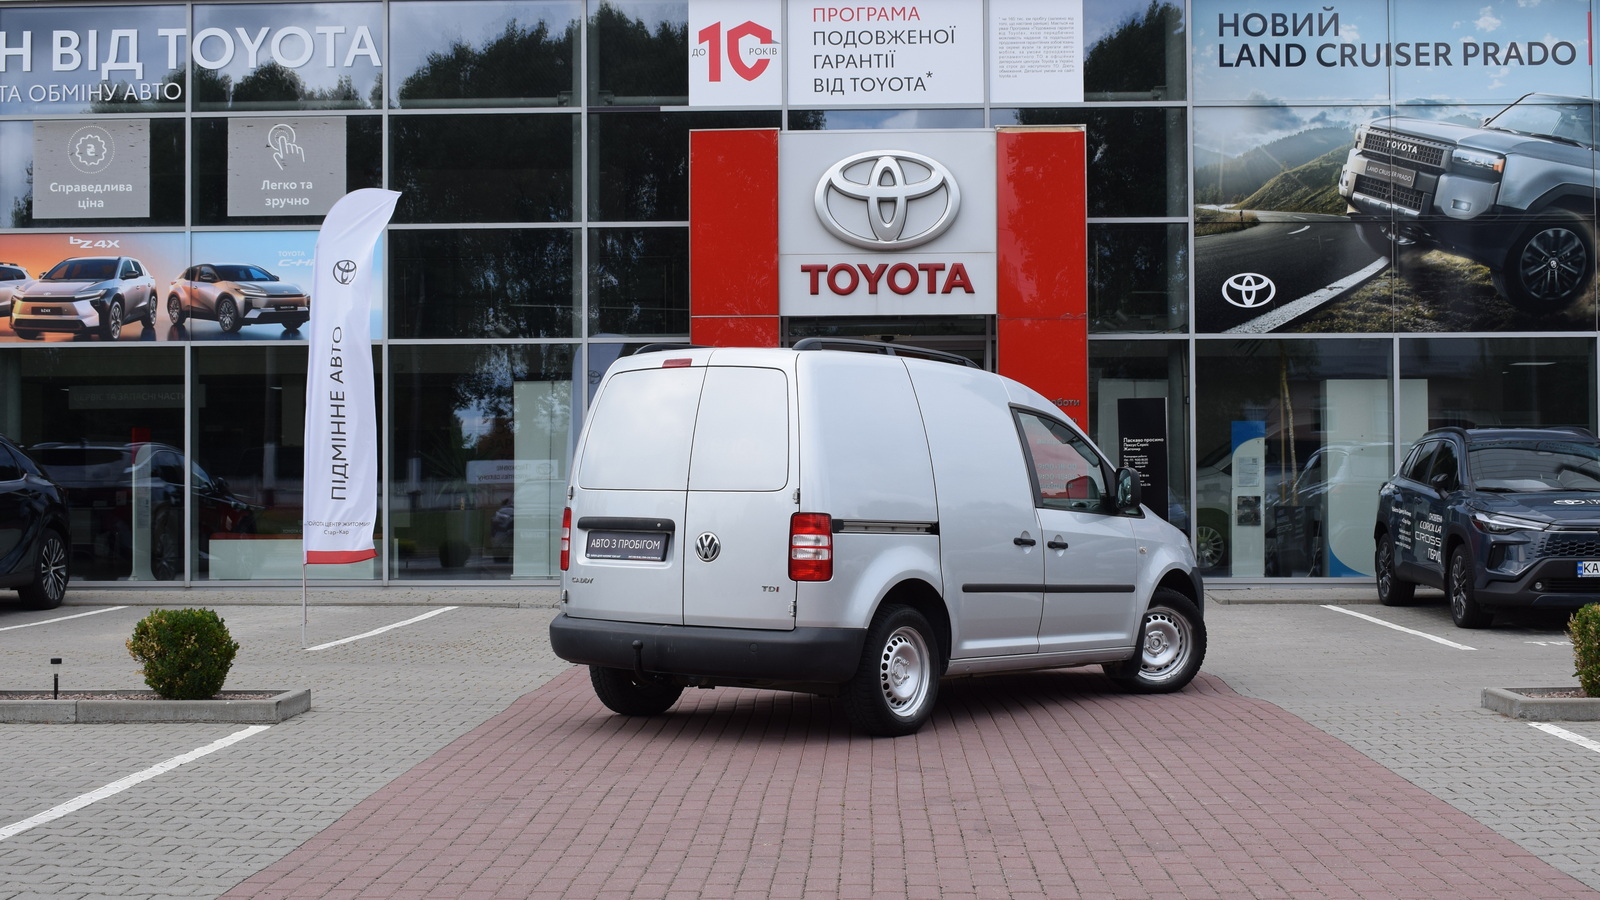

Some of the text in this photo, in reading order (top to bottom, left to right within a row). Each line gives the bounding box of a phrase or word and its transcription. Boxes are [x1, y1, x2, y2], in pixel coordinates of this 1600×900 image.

[813, 5, 921, 22] ПРОГРАМА
[1218, 7, 1340, 37] НОВИЙ
[813, 25, 956, 49] ПОДОВЖЕНОЇ
[52, 29, 143, 80] ВІД
[158, 26, 382, 70] TOYOTA
[692, 48, 706, 58] ДО
[698, 20, 772, 82] 10
[748, 48, 778, 56] РОКІВ
[1218, 41, 1576, 68] LAND CRUISER PRADO
[813, 49, 896, 70] ГАРАНТІЇ
[29, 83, 117, 102] ОБМІНУ
[123, 82, 181, 101] АВТО
[813, 78, 844, 95] ВІД
[1386, 140, 1417, 154] TOYOTA
[1397, 172, 1412, 182] PRADO
[50, 182, 132, 194] Справедлива
[261, 180, 313, 192] Легко та
[78, 198, 104, 209] ціна
[265, 195, 310, 208] зручно
[70, 236, 120, 248] bZ4X
[801, 262, 975, 296] TOYOTA
[1051, 398, 1080, 406] оботи
[330, 326, 349, 500] ПІДМІННЕ АВТО
[1420, 520, 1442, 534] COROLLA
[590, 538, 661, 550] АВТО З ПРОБІГОМ
[1414, 531, 1441, 547] CROSS
